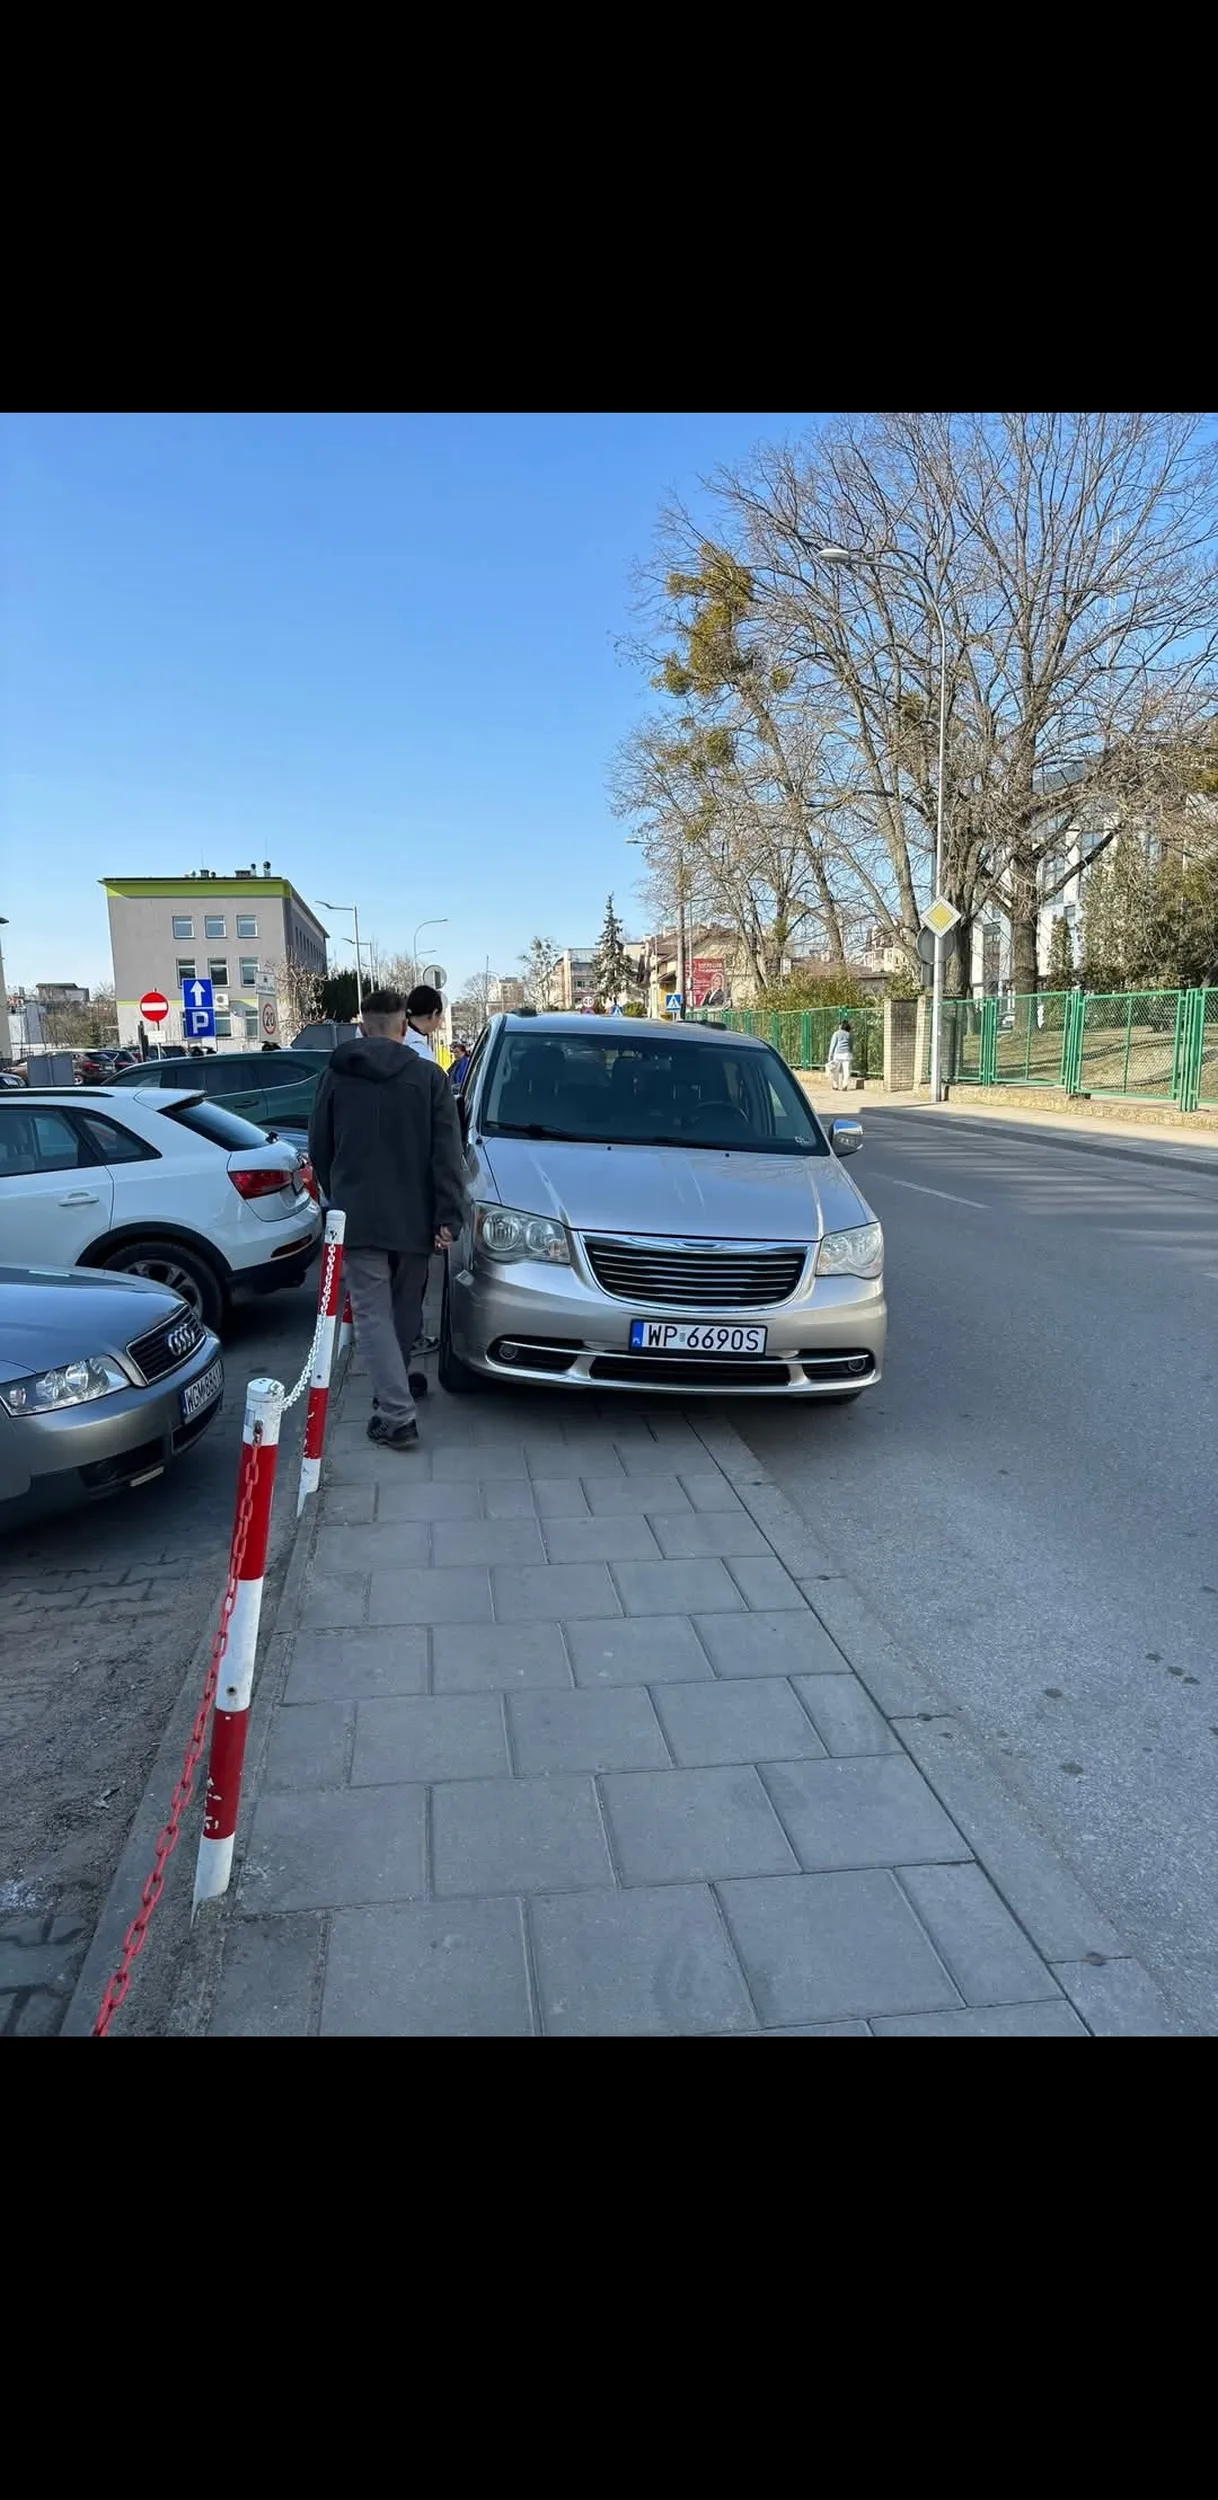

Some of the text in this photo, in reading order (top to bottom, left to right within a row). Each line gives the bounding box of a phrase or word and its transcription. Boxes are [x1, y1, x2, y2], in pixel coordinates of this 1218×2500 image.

[192, 1011, 209, 1035] P
[648, 1324, 759, 1351] WP 6690S
